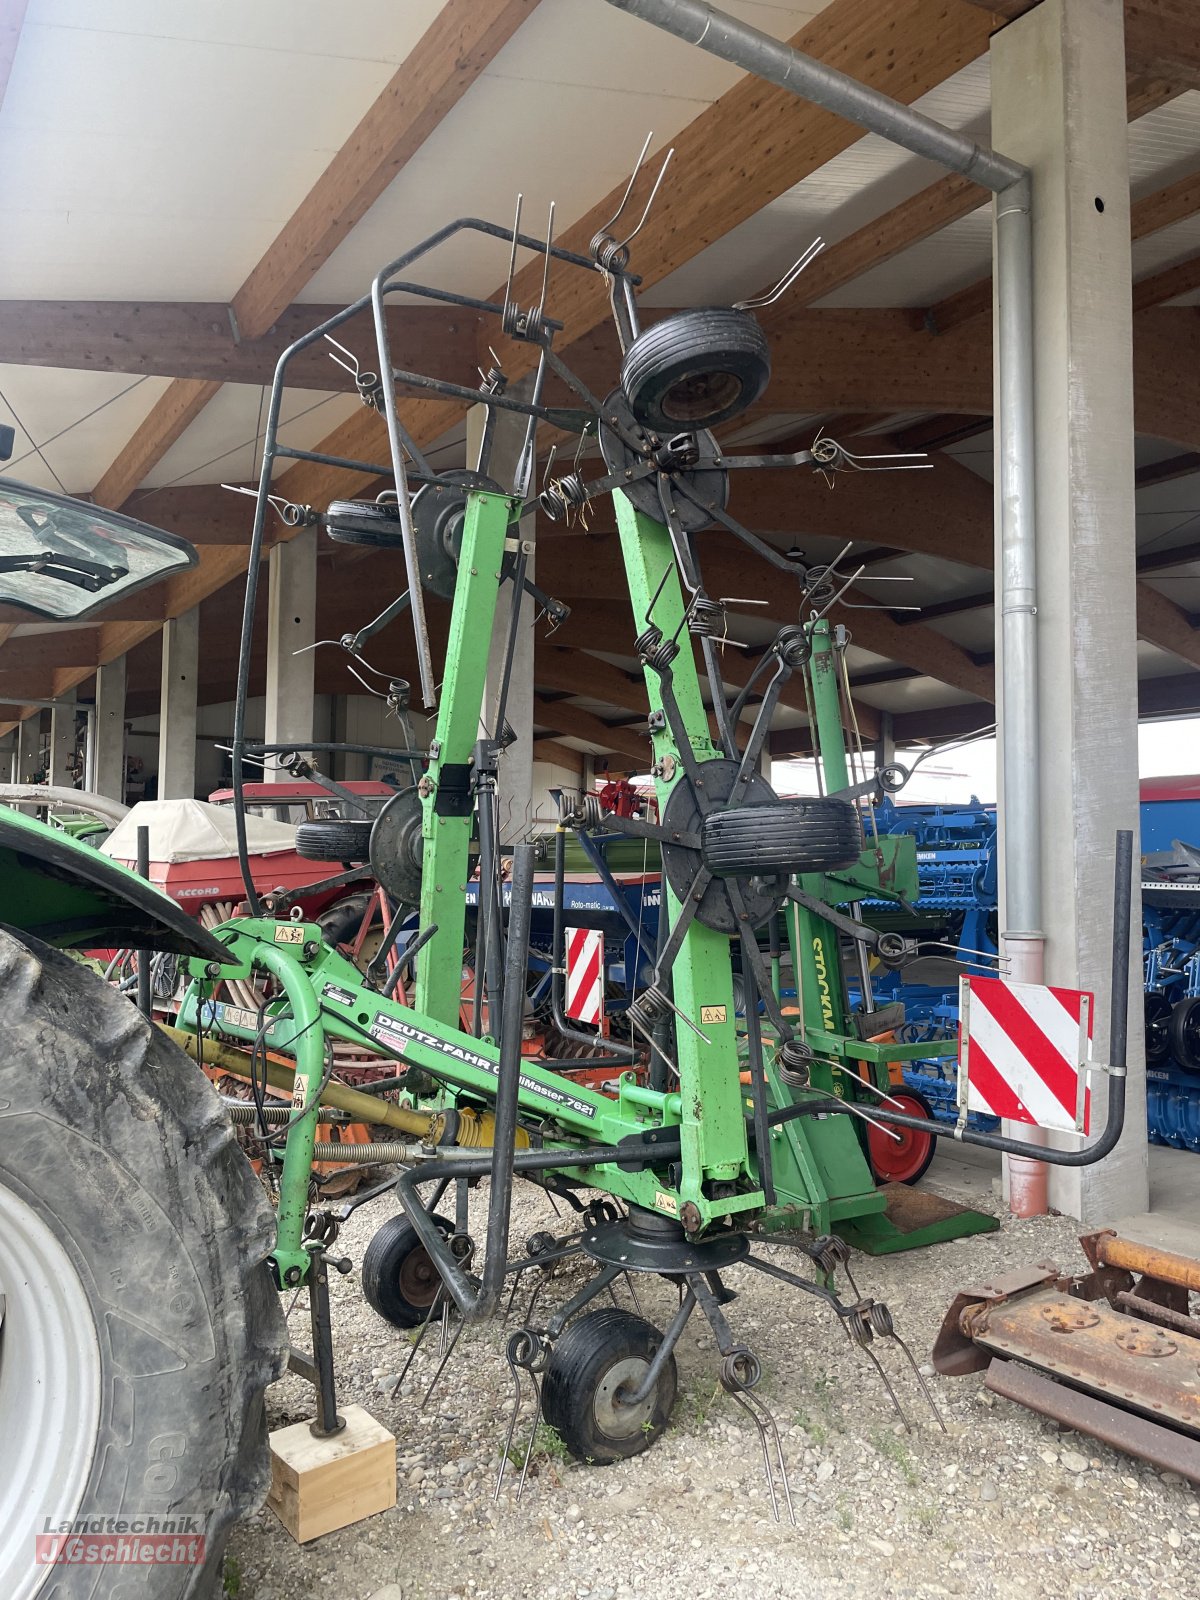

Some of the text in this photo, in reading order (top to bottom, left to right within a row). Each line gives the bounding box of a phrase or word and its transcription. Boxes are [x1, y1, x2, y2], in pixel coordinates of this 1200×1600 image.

[916, 852, 936, 860] EMKEN
[176, 887, 220, 897] ACCORD
[570, 900, 601, 910] Roto-matic
[813, 937, 842, 1077] STOCKMN
[378, 1014, 491, 1071] DEUTZ-FAHR
[566, 1097, 594, 1116] 7621
